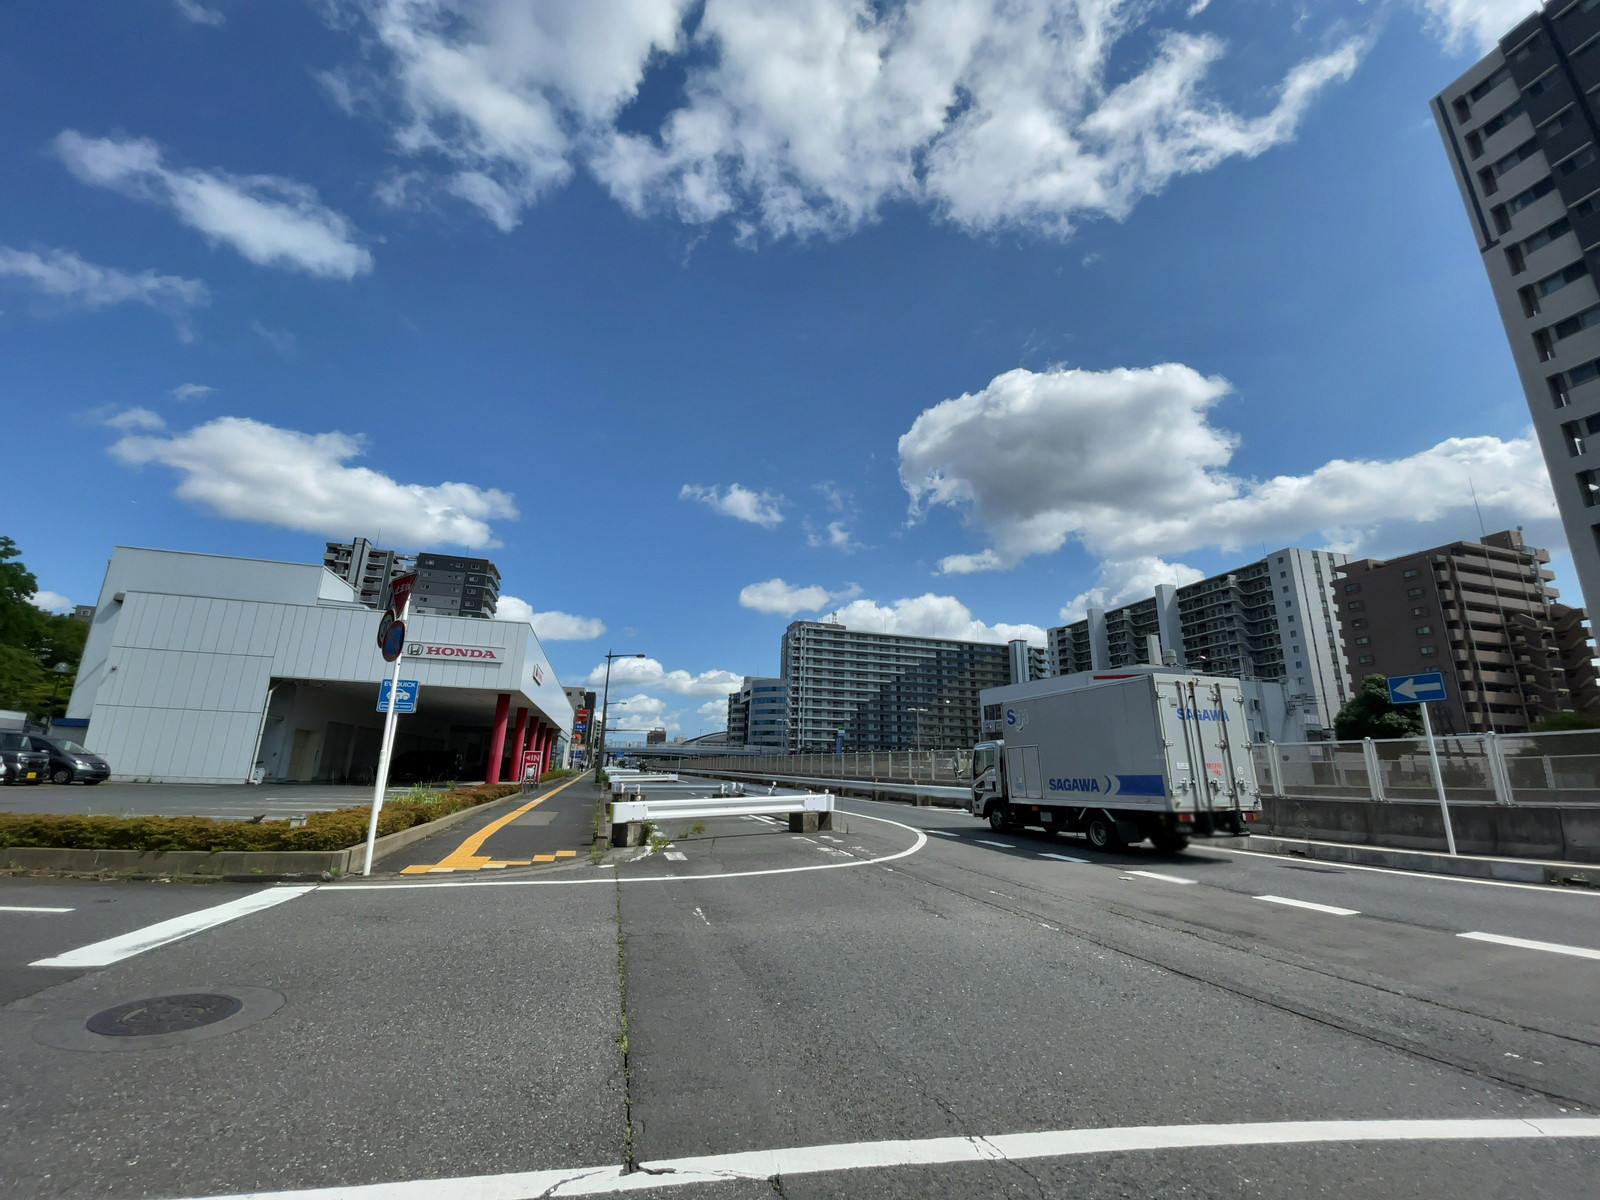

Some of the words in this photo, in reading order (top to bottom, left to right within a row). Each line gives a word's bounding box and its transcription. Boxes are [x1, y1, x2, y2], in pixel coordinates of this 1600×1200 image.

[426, 646, 497, 659] HONDA
[1176, 707, 1230, 722] SAGAWA
[530, 754, 540, 762] IN
[1048, 777, 1101, 793] SAGAWA
